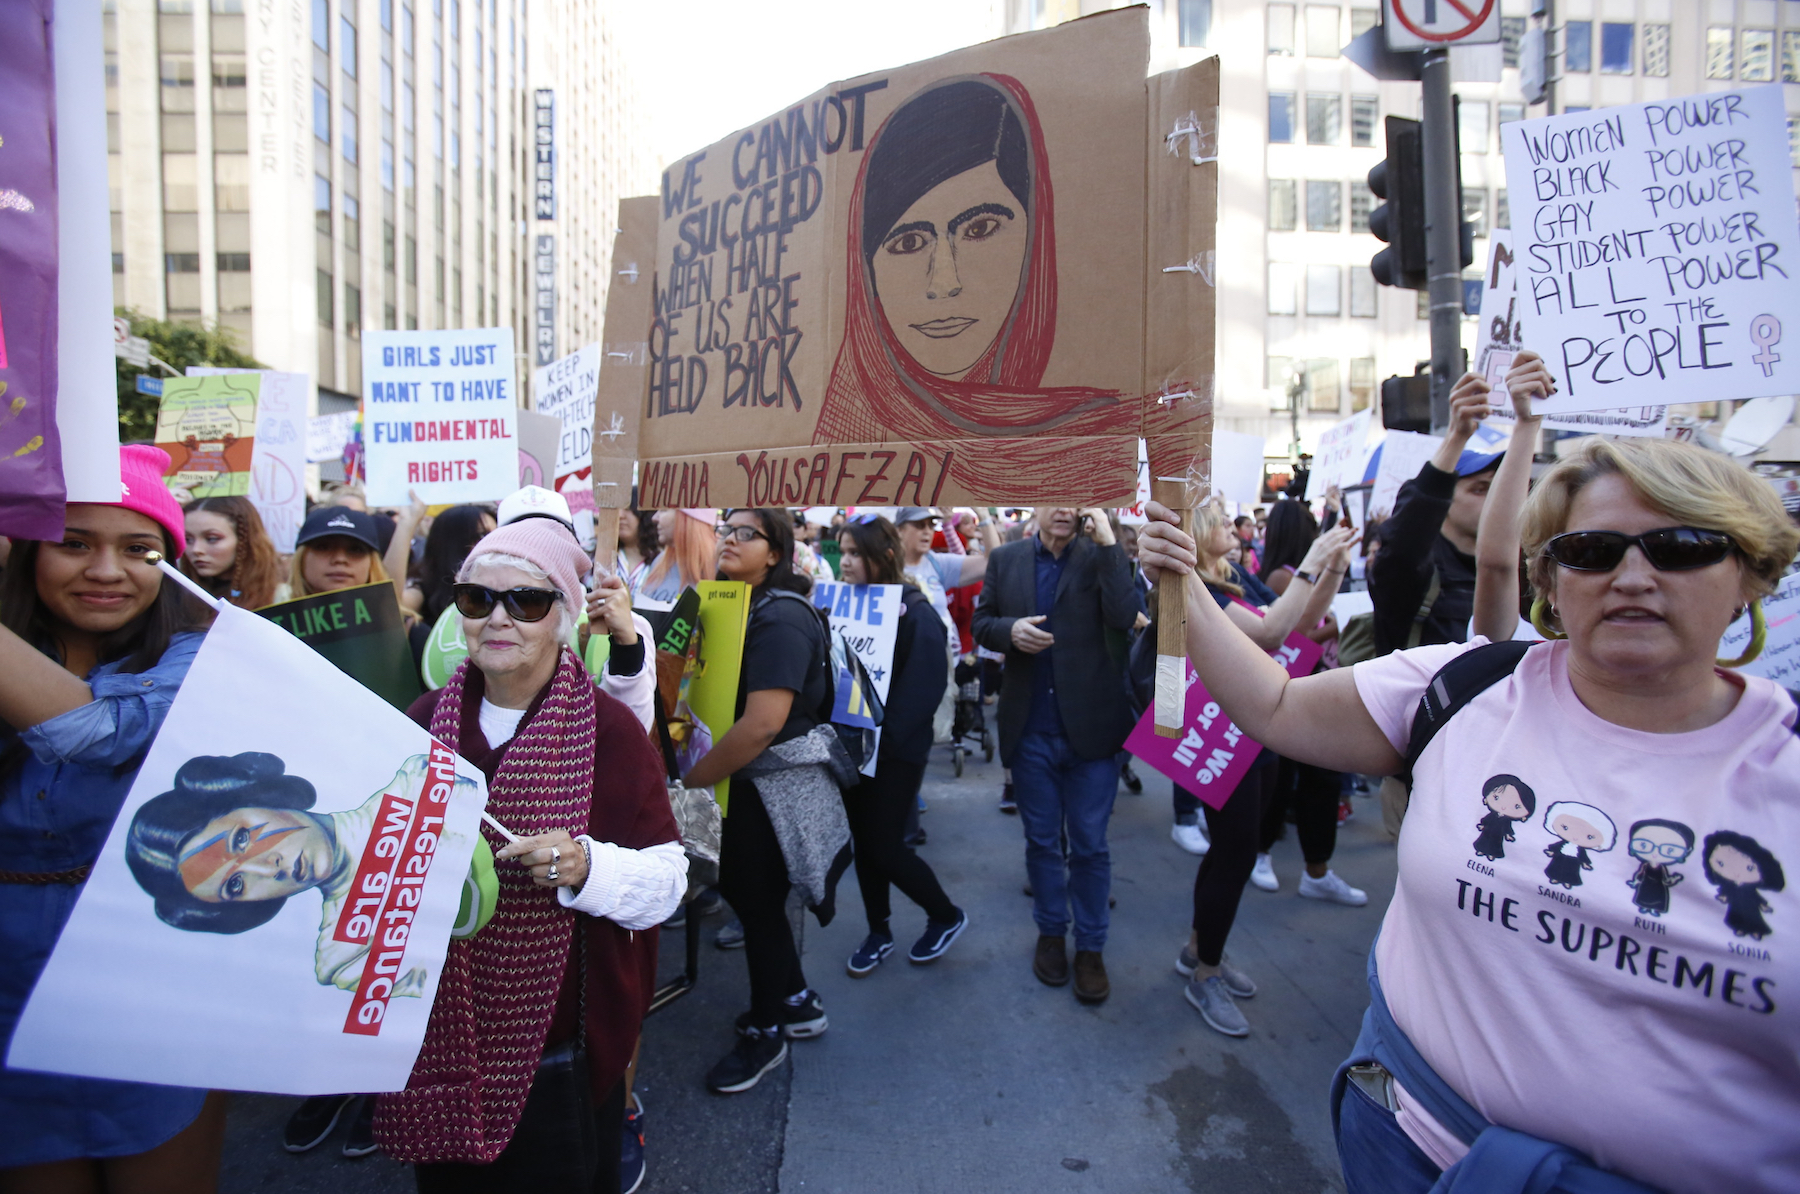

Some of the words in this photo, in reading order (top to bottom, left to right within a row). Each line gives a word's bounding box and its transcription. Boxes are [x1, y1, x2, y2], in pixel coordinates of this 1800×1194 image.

[1644, 94, 1750, 147] POWER
[536, 90, 554, 219] WESTERN
[662, 151, 708, 221] WE
[732, 78, 889, 192] CANNOT
[1533, 160, 1620, 202] BLACK
[1644, 140, 1750, 183] POWER
[673, 163, 824, 265] SUCCEED
[1534, 200, 1594, 243] GAY
[1641, 170, 1760, 219] POWER
[1527, 229, 1655, 275] STUDENT
[1659, 212, 1766, 254] POWER
[652, 255, 714, 318] WHEN
[726, 228, 794, 297] HALF
[1530, 266, 1648, 316] ALL
[1647, 242, 1789, 297] POWER
[536, 236, 554, 364] JEWELRY
[648, 310, 684, 363] OF
[694, 296, 734, 355] US
[743, 271, 802, 342] ARE
[1603, 309, 1647, 335] TO
[1664, 296, 1725, 324] THE
[382, 345, 441, 368] GIRLS
[450, 344, 497, 367] JUST
[546, 354, 581, 387] KEEP
[647, 354, 708, 418] HELD
[722, 330, 804, 413] BACK
[1561, 321, 1733, 397] PEOPLE
[371, 381, 422, 403] WANT
[430, 381, 455, 403] TO
[461, 379, 507, 402] HAVE
[536, 381, 573, 413] WOMEN
[579, 369, 595, 392] IN
[373, 418, 512, 443] FUNDAMENTAL
[408, 459, 478, 484] RIGHTS
[735, 450, 955, 510] YOUSAFZAI
[719, 589, 738, 599] vocal
[814, 583, 885, 626] HATE
[289, 602, 348, 638] LIKE
[354, 598, 373, 625] A
[1171, 727, 1206, 768] All
[1195, 748, 1236, 786] We
[1466, 858, 1496, 878] ELENA
[1536, 884, 1582, 909] SANDRA
[1455, 878, 1520, 933] THE
[1534, 909, 1777, 1015] SUPREMES
[1634, 916, 1667, 936] RUTH
[1726, 941, 1773, 963] SONIA
